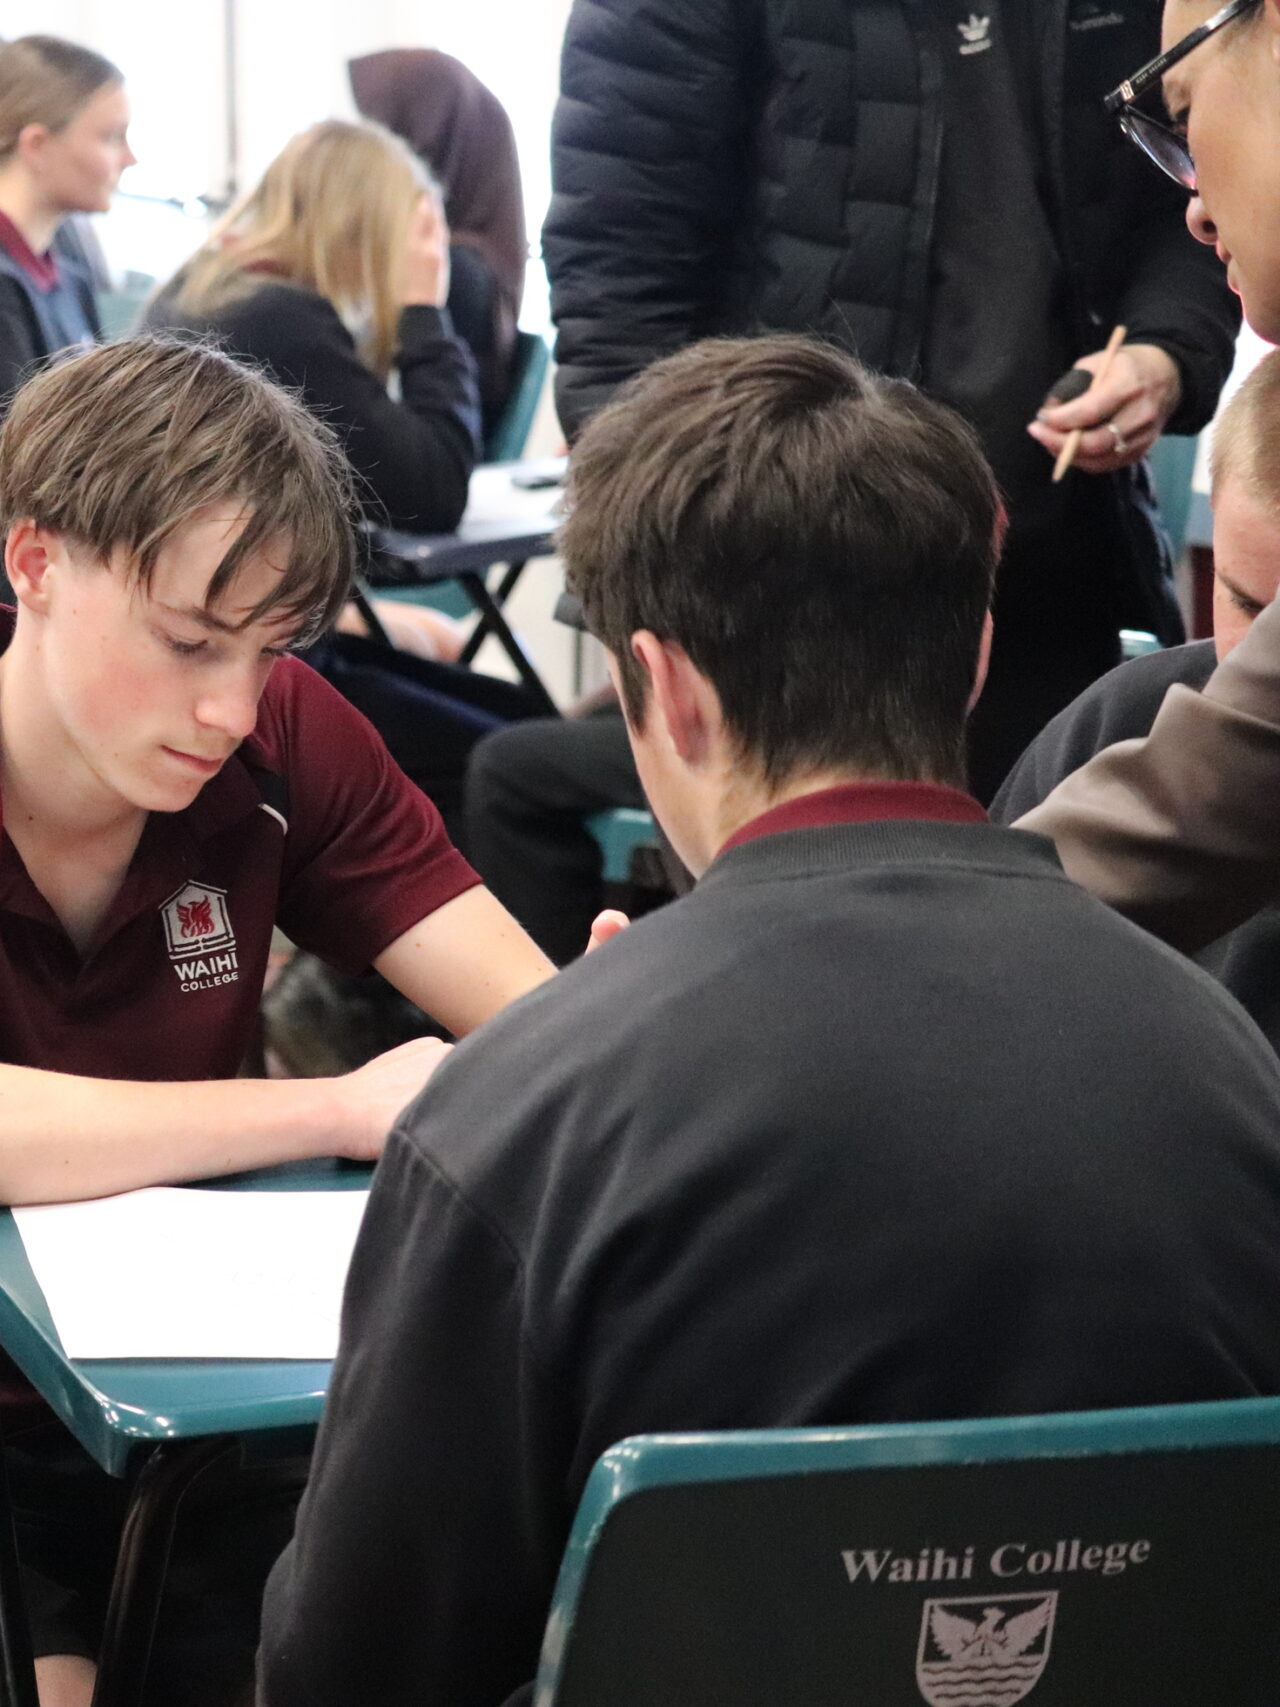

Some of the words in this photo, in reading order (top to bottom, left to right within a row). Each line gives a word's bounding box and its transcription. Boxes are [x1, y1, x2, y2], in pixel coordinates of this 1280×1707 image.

[180, 971, 239, 992] COLLEGE
[841, 1546, 974, 1584] Waihi
[989, 1539, 1152, 1577] College
